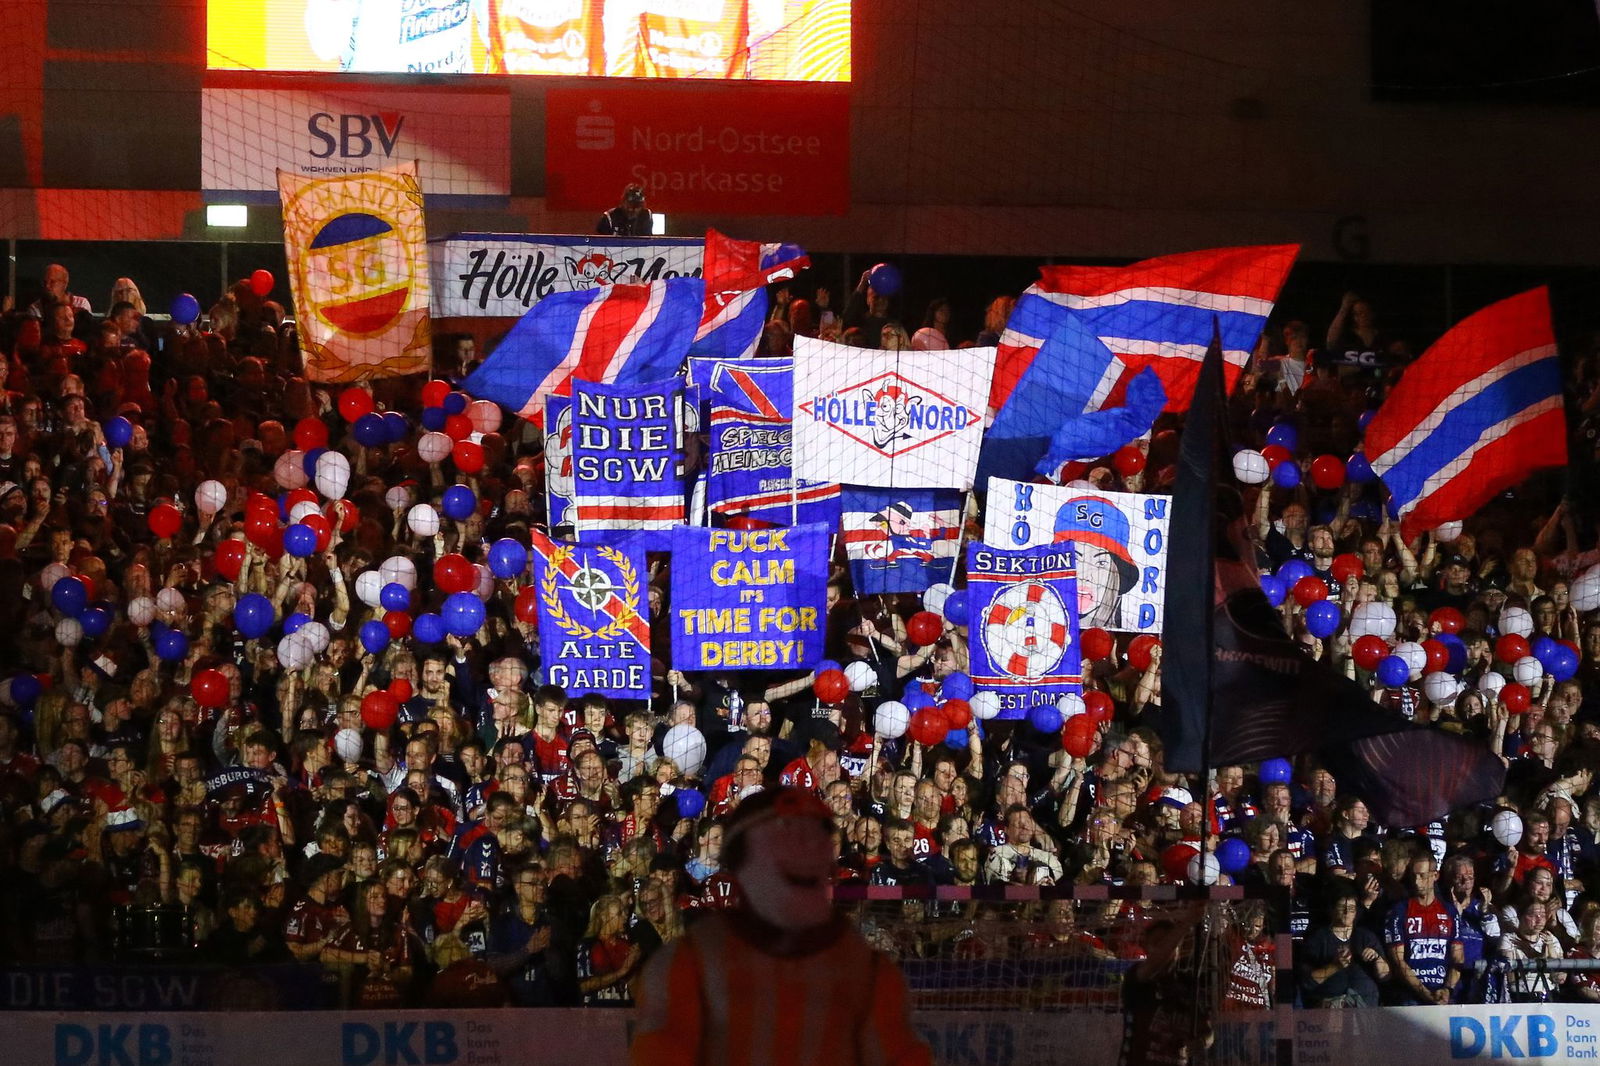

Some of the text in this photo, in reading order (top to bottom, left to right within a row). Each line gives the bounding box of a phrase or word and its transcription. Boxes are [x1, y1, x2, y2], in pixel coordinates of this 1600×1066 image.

[308, 112, 404, 159] SBV
[632, 126, 820, 155] Nord-Ostsee
[631, 164, 783, 195] Sparkasse
[459, 249, 559, 309] Hölle
[1344, 350, 1376, 365] SG
[579, 392, 667, 420] NUR
[813, 392, 967, 430] HÖLLE NORD
[580, 424, 668, 451] DIE
[579, 456, 668, 482] SGW
[1077, 504, 1103, 528] SG
[709, 529, 790, 553] FUCK
[710, 559, 795, 587] CALM
[975, 552, 1072, 573] SEKTION
[1138, 499, 1167, 629] NORD
[680, 606, 818, 635] TIME FOR
[559, 641, 635, 659] ALTE
[701, 640, 804, 667] DERBY!
[550, 665, 644, 689] GARDE
[565, 710, 577, 725] 17
[913, 838, 930, 854] 26
[717, 881, 731, 897] 17
[1407, 917, 1422, 934] 27
[1419, 943, 1446, 954] JYSK
[8, 972, 199, 1007] DIE SGW
[466, 1020, 493, 1033] Das
[1566, 1015, 1590, 1027] Das
[55, 1024, 173, 1066] DKB
[342, 1021, 459, 1065] DKB
[466, 1037, 500, 1049] kann
[1449, 1015, 1558, 1059] DKB
[1566, 1030, 1597, 1043] kann
[466, 1052, 502, 1065] Bank
[1567, 1046, 1598, 1058] Bank
